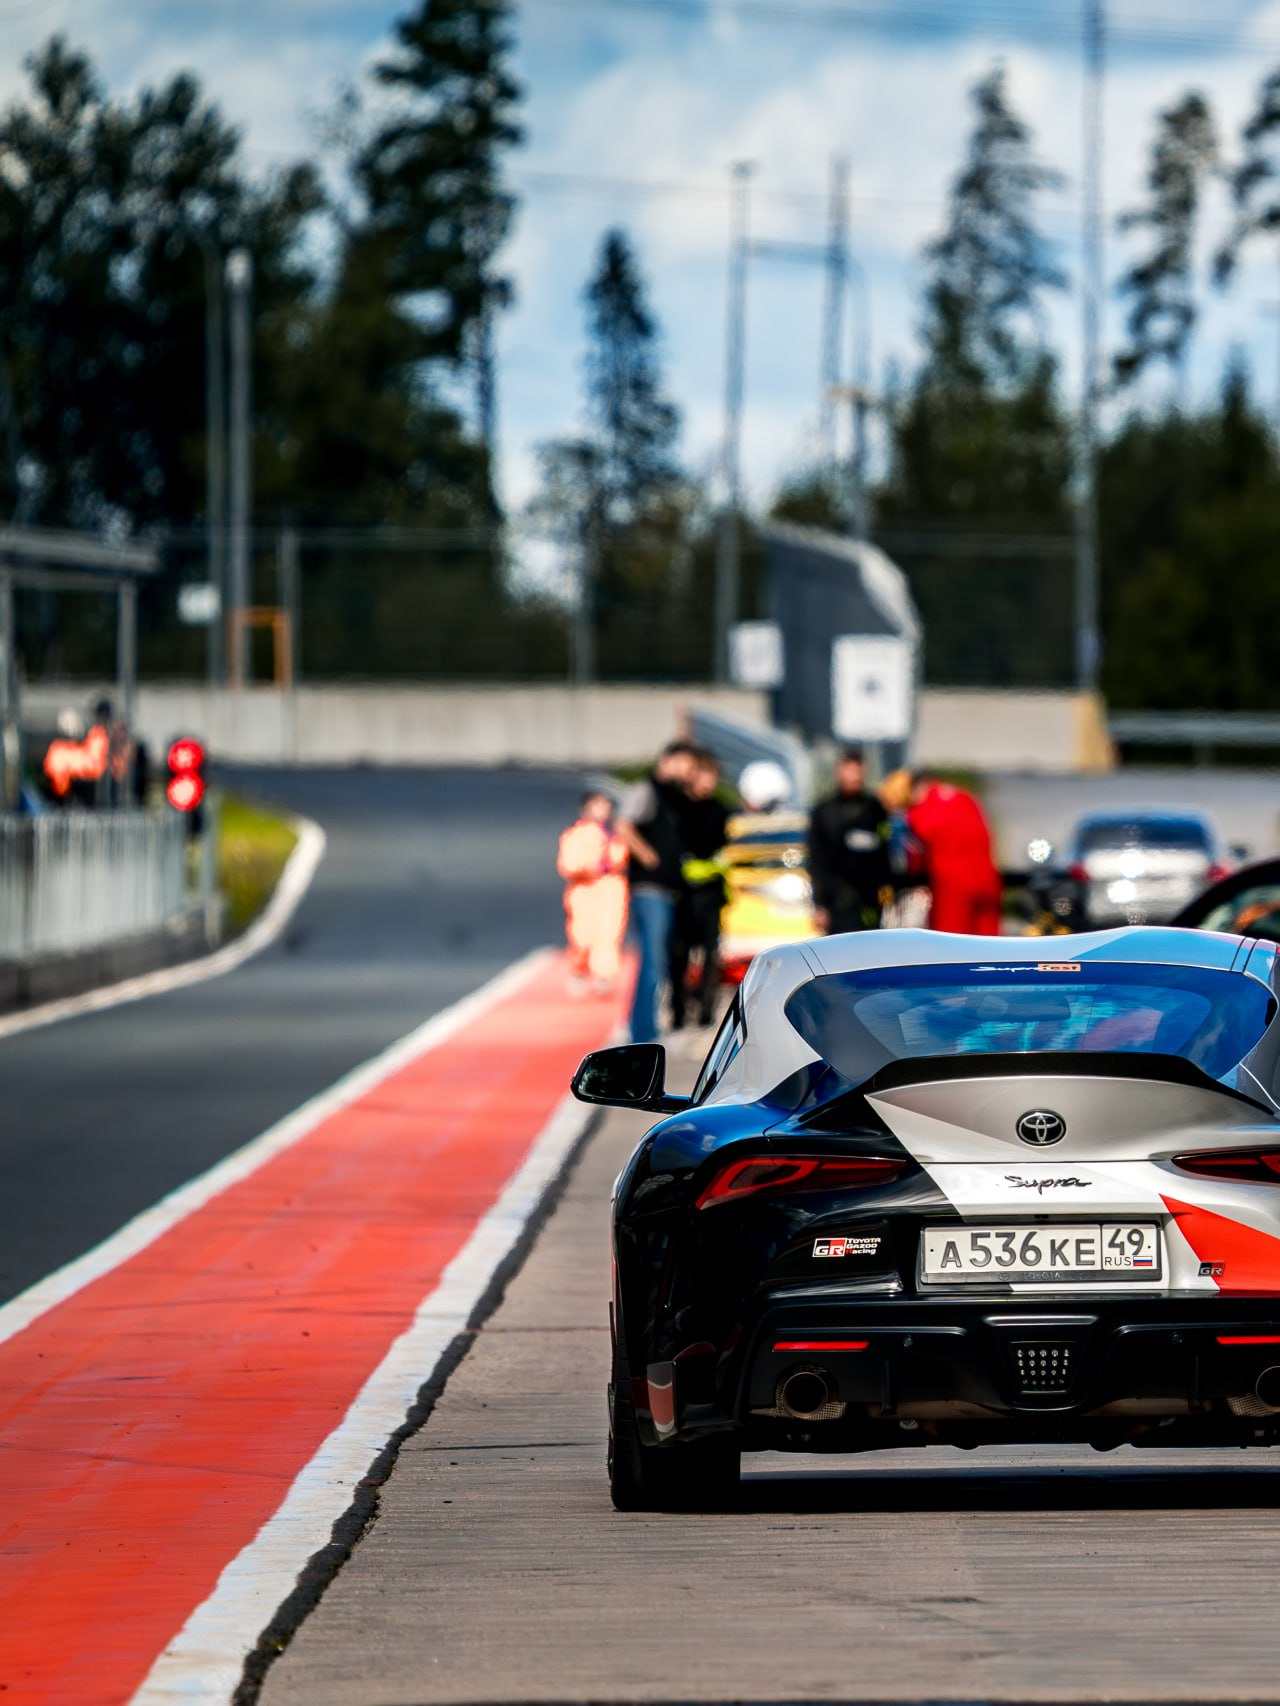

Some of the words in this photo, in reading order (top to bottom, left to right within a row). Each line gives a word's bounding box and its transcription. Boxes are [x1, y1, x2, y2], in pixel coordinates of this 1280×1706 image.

[1004, 1175, 1092, 1195] Supra
[1107, 1228, 1145, 1256] 49
[1104, 1256, 1132, 1266] RUS
